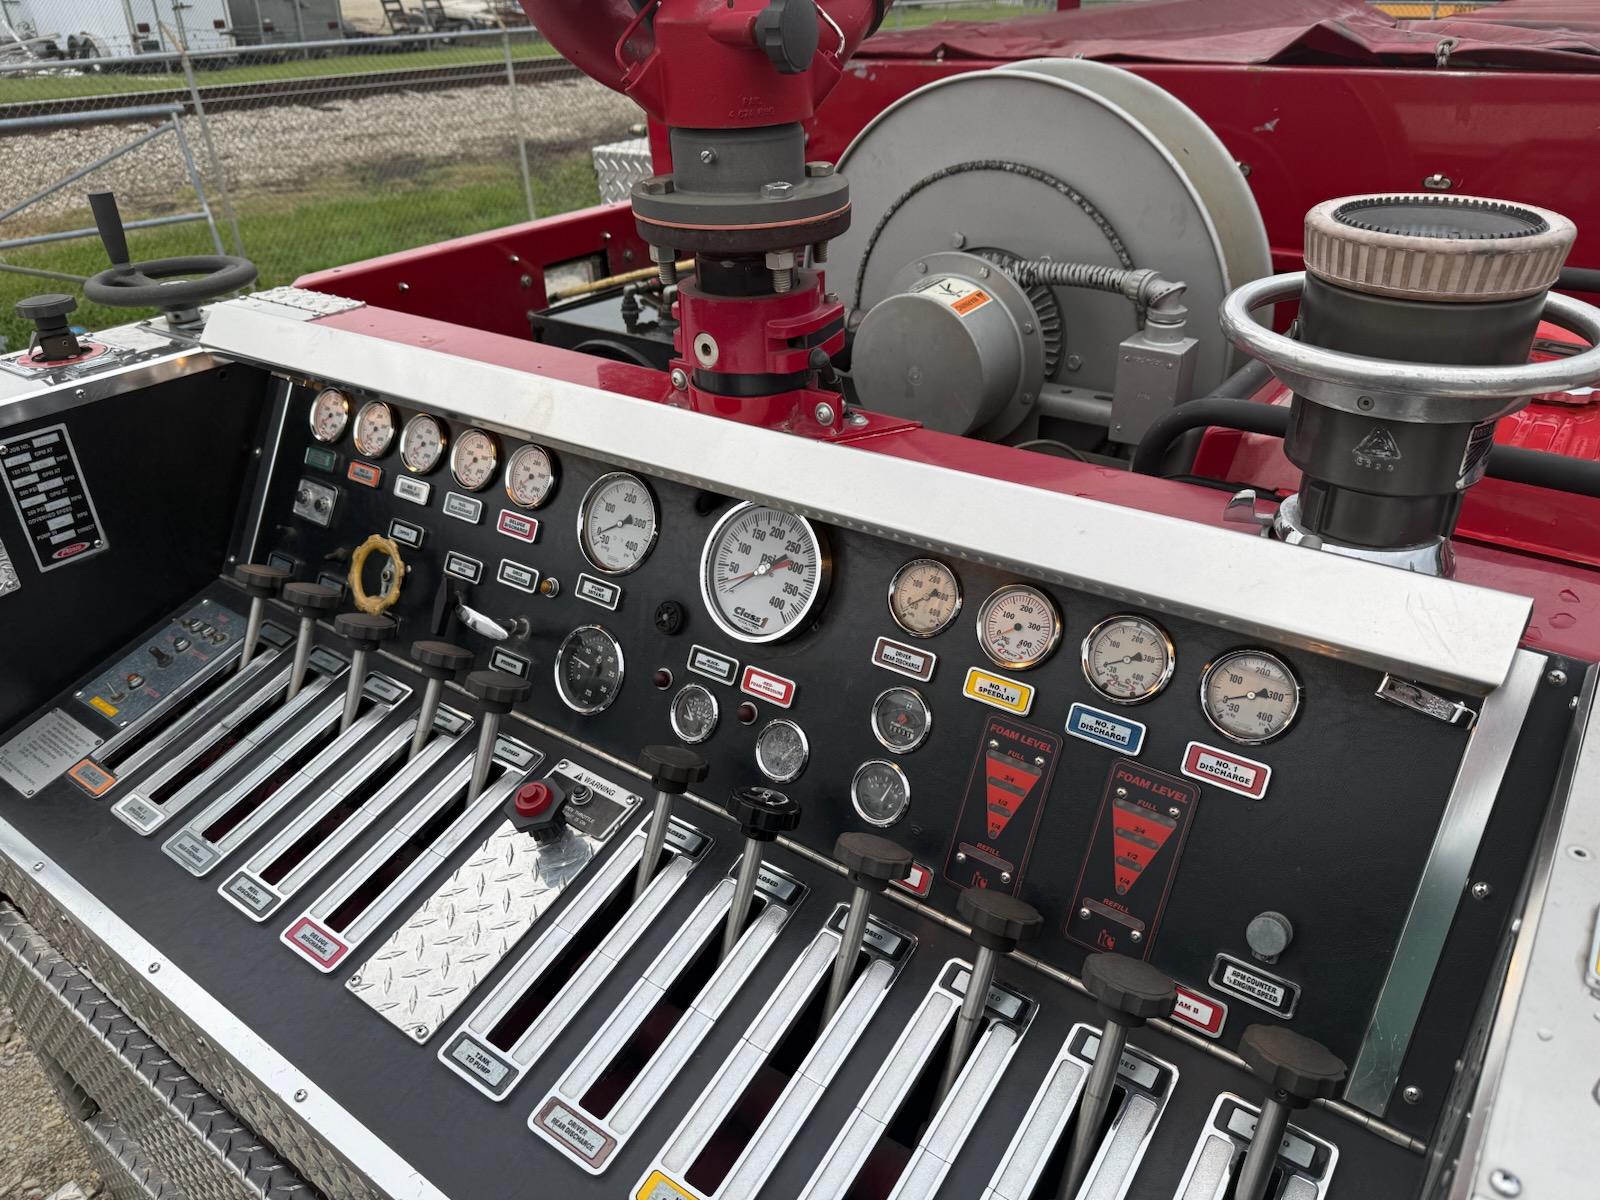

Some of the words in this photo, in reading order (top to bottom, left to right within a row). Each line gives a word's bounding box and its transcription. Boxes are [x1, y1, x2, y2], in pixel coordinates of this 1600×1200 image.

[624, 492, 637, 504] 200
[605, 502, 616, 512] 100
[504, 522, 528, 534] DISCHARGE
[509, 518, 526, 528] DELUGE
[634, 518, 646, 529] 300
[752, 528, 766, 542] 150
[769, 526, 786, 540] 200
[626, 540, 638, 552] 400
[738, 542, 752, 556] 100
[785, 540, 800, 554] 250
[760, 552, 776, 565] psi
[728, 562, 740, 574] 50
[788, 560, 804, 574] 300
[588, 589, 604, 598] INTAKE
[782, 582, 798, 597] 350
[769, 596, 786, 610] 400
[1020, 604, 1034, 614] 200
[1002, 610, 1016, 620] 100
[1028, 622, 1041, 632] 300
[1018, 639, 1032, 649] 400
[1110, 640, 1120, 649] 100
[1131, 634, 1144, 645] 200
[895, 650, 912, 660] DRIVER
[1143, 655, 1156, 664] 300
[884, 653, 896, 664] REAR
[896, 657, 920, 671] DISCHARGE
[1132, 673, 1144, 682] 400
[1229, 673, 1244, 685] 100
[1255, 668, 1271, 678] 200
[988, 682, 1002, 692] NO.
[978, 686, 1016, 704] SPEEDLAY
[1268, 690, 1284, 702] 300
[1226, 704, 1240, 714] -30
[1256, 712, 1274, 723] 400
[1094, 719, 1110, 730] NO.
[990, 724, 1020, 744] FOAM
[1020, 736, 1053, 753] LEVEL
[1080, 722, 1128, 743] DISCHARGE
[501, 746, 520, 758] CLOSED
[1007, 750, 1025, 760] FULL
[1215, 759, 1232, 771] NO.
[1200, 762, 1251, 786] DISCHARGE
[582, 776, 616, 797] WARNING
[1116, 770, 1151, 790] FOAM
[1151, 783, 1189, 804] LEVEL
[1136, 799, 1158, 812] FULL
[1134, 824, 1146, 834] 3/4
[976, 842, 1000, 857] REFILL
[1126, 851, 1138, 861] 1/2
[758, 874, 779, 888] LOSED
[1119, 876, 1130, 886] 1/4
[236, 886, 262, 905] DISCHARGE
[1103, 898, 1130, 914] REFILL
[310, 932, 328, 948] DELUGE
[864, 928, 883, 940] OSED
[301, 934, 328, 956] DISCHARGE
[1232, 970, 1246, 983] RPM
[1246, 974, 1277, 994] COUNTER
[1232, 979, 1256, 994] ENGINE
[1256, 988, 1278, 1004] SPEED
[474, 1050, 492, 1066] TANK
[466, 1055, 475, 1066] TO
[472, 1059, 491, 1076] PUMP
[1120, 1059, 1136, 1072] SED
[567, 1119, 588, 1136] DRIVER
[551, 1117, 566, 1133] REAR
[564, 1124, 594, 1152] DISCHARGE
